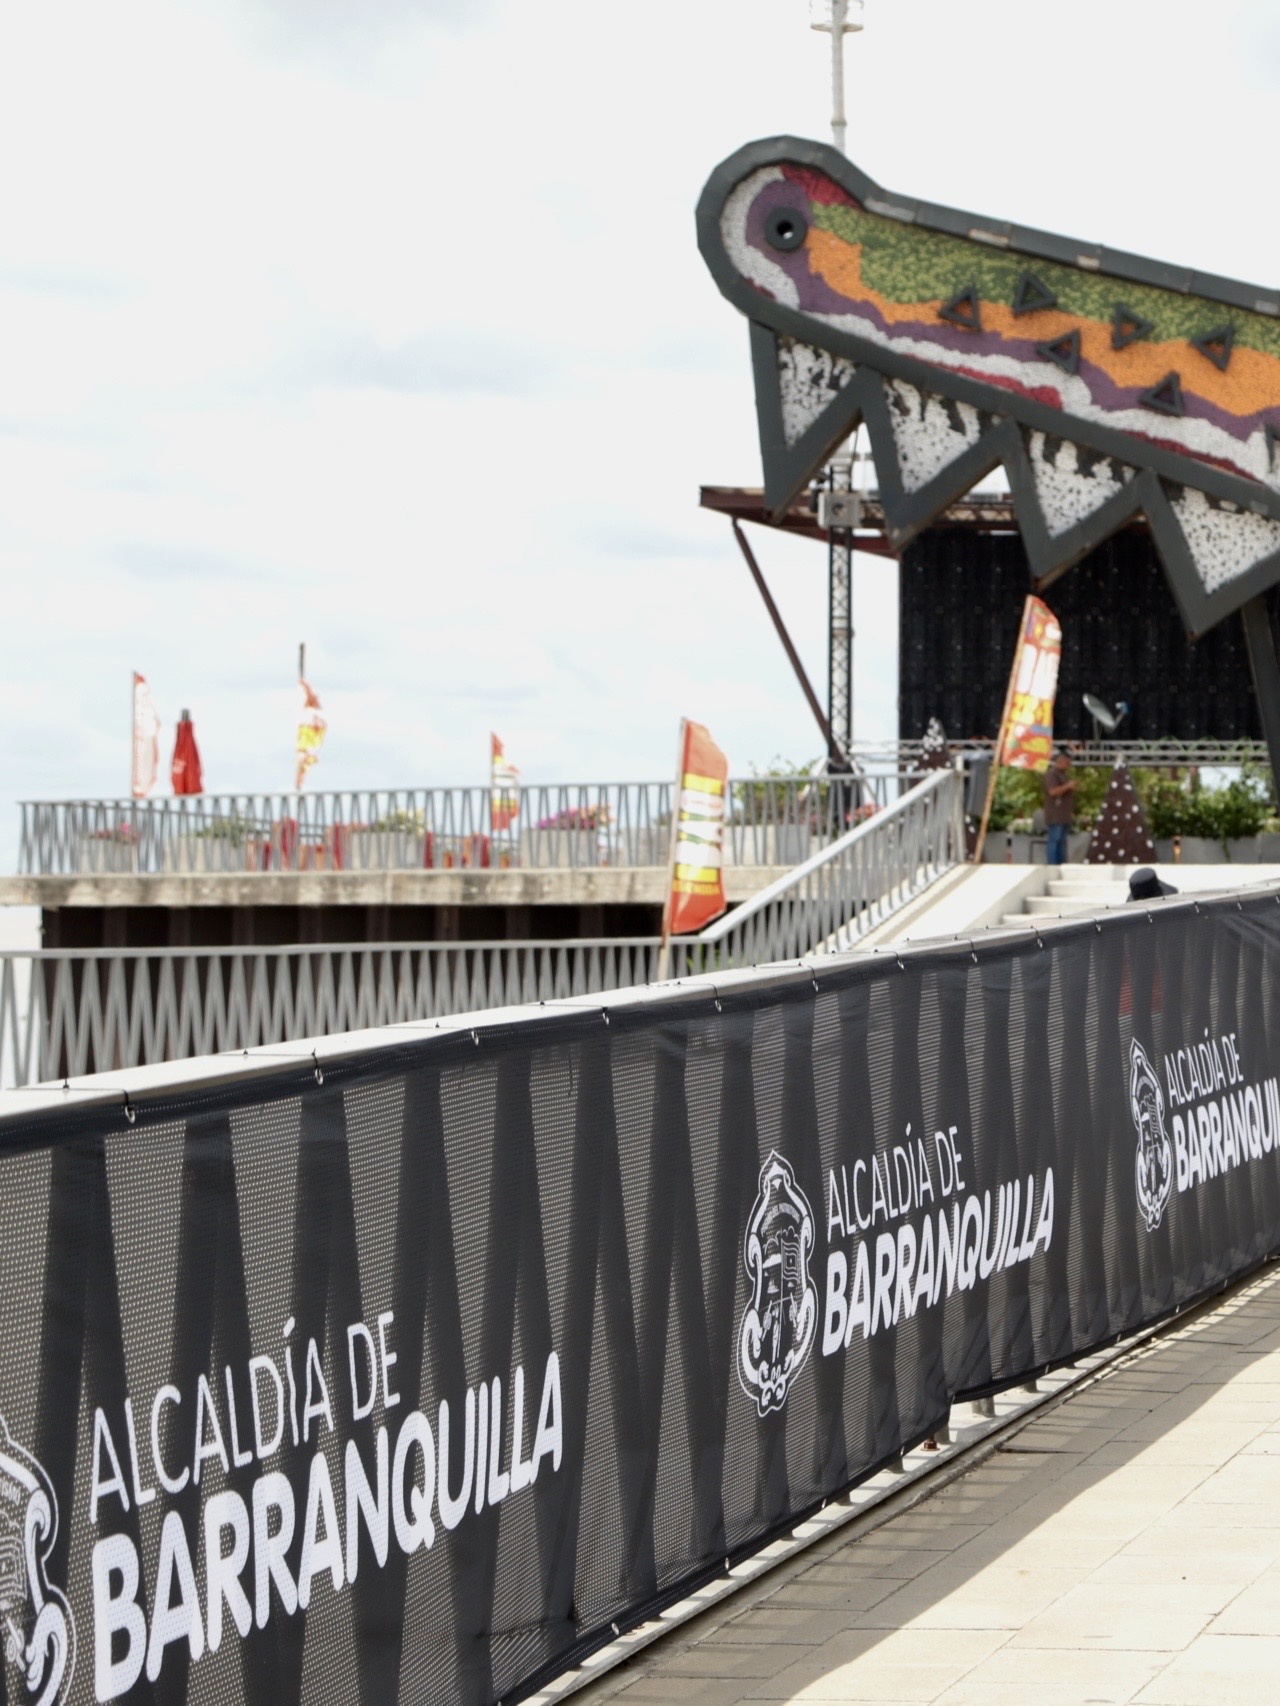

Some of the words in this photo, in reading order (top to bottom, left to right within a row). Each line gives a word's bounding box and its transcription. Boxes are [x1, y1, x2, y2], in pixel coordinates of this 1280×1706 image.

[1165, 1027, 1226, 1108] ALCALDÍA
[1221, 1033, 1244, 1085] DE
[822, 1167, 1054, 1357] BARRANQUILLA
[828, 1122, 934, 1243] ALCALDÍA
[934, 1126, 965, 1197] DE
[90, 1317, 334, 1523] ALCALDÍA
[347, 1311, 401, 1420] DE
[92, 1351, 563, 1703] BARRANQUILLA
